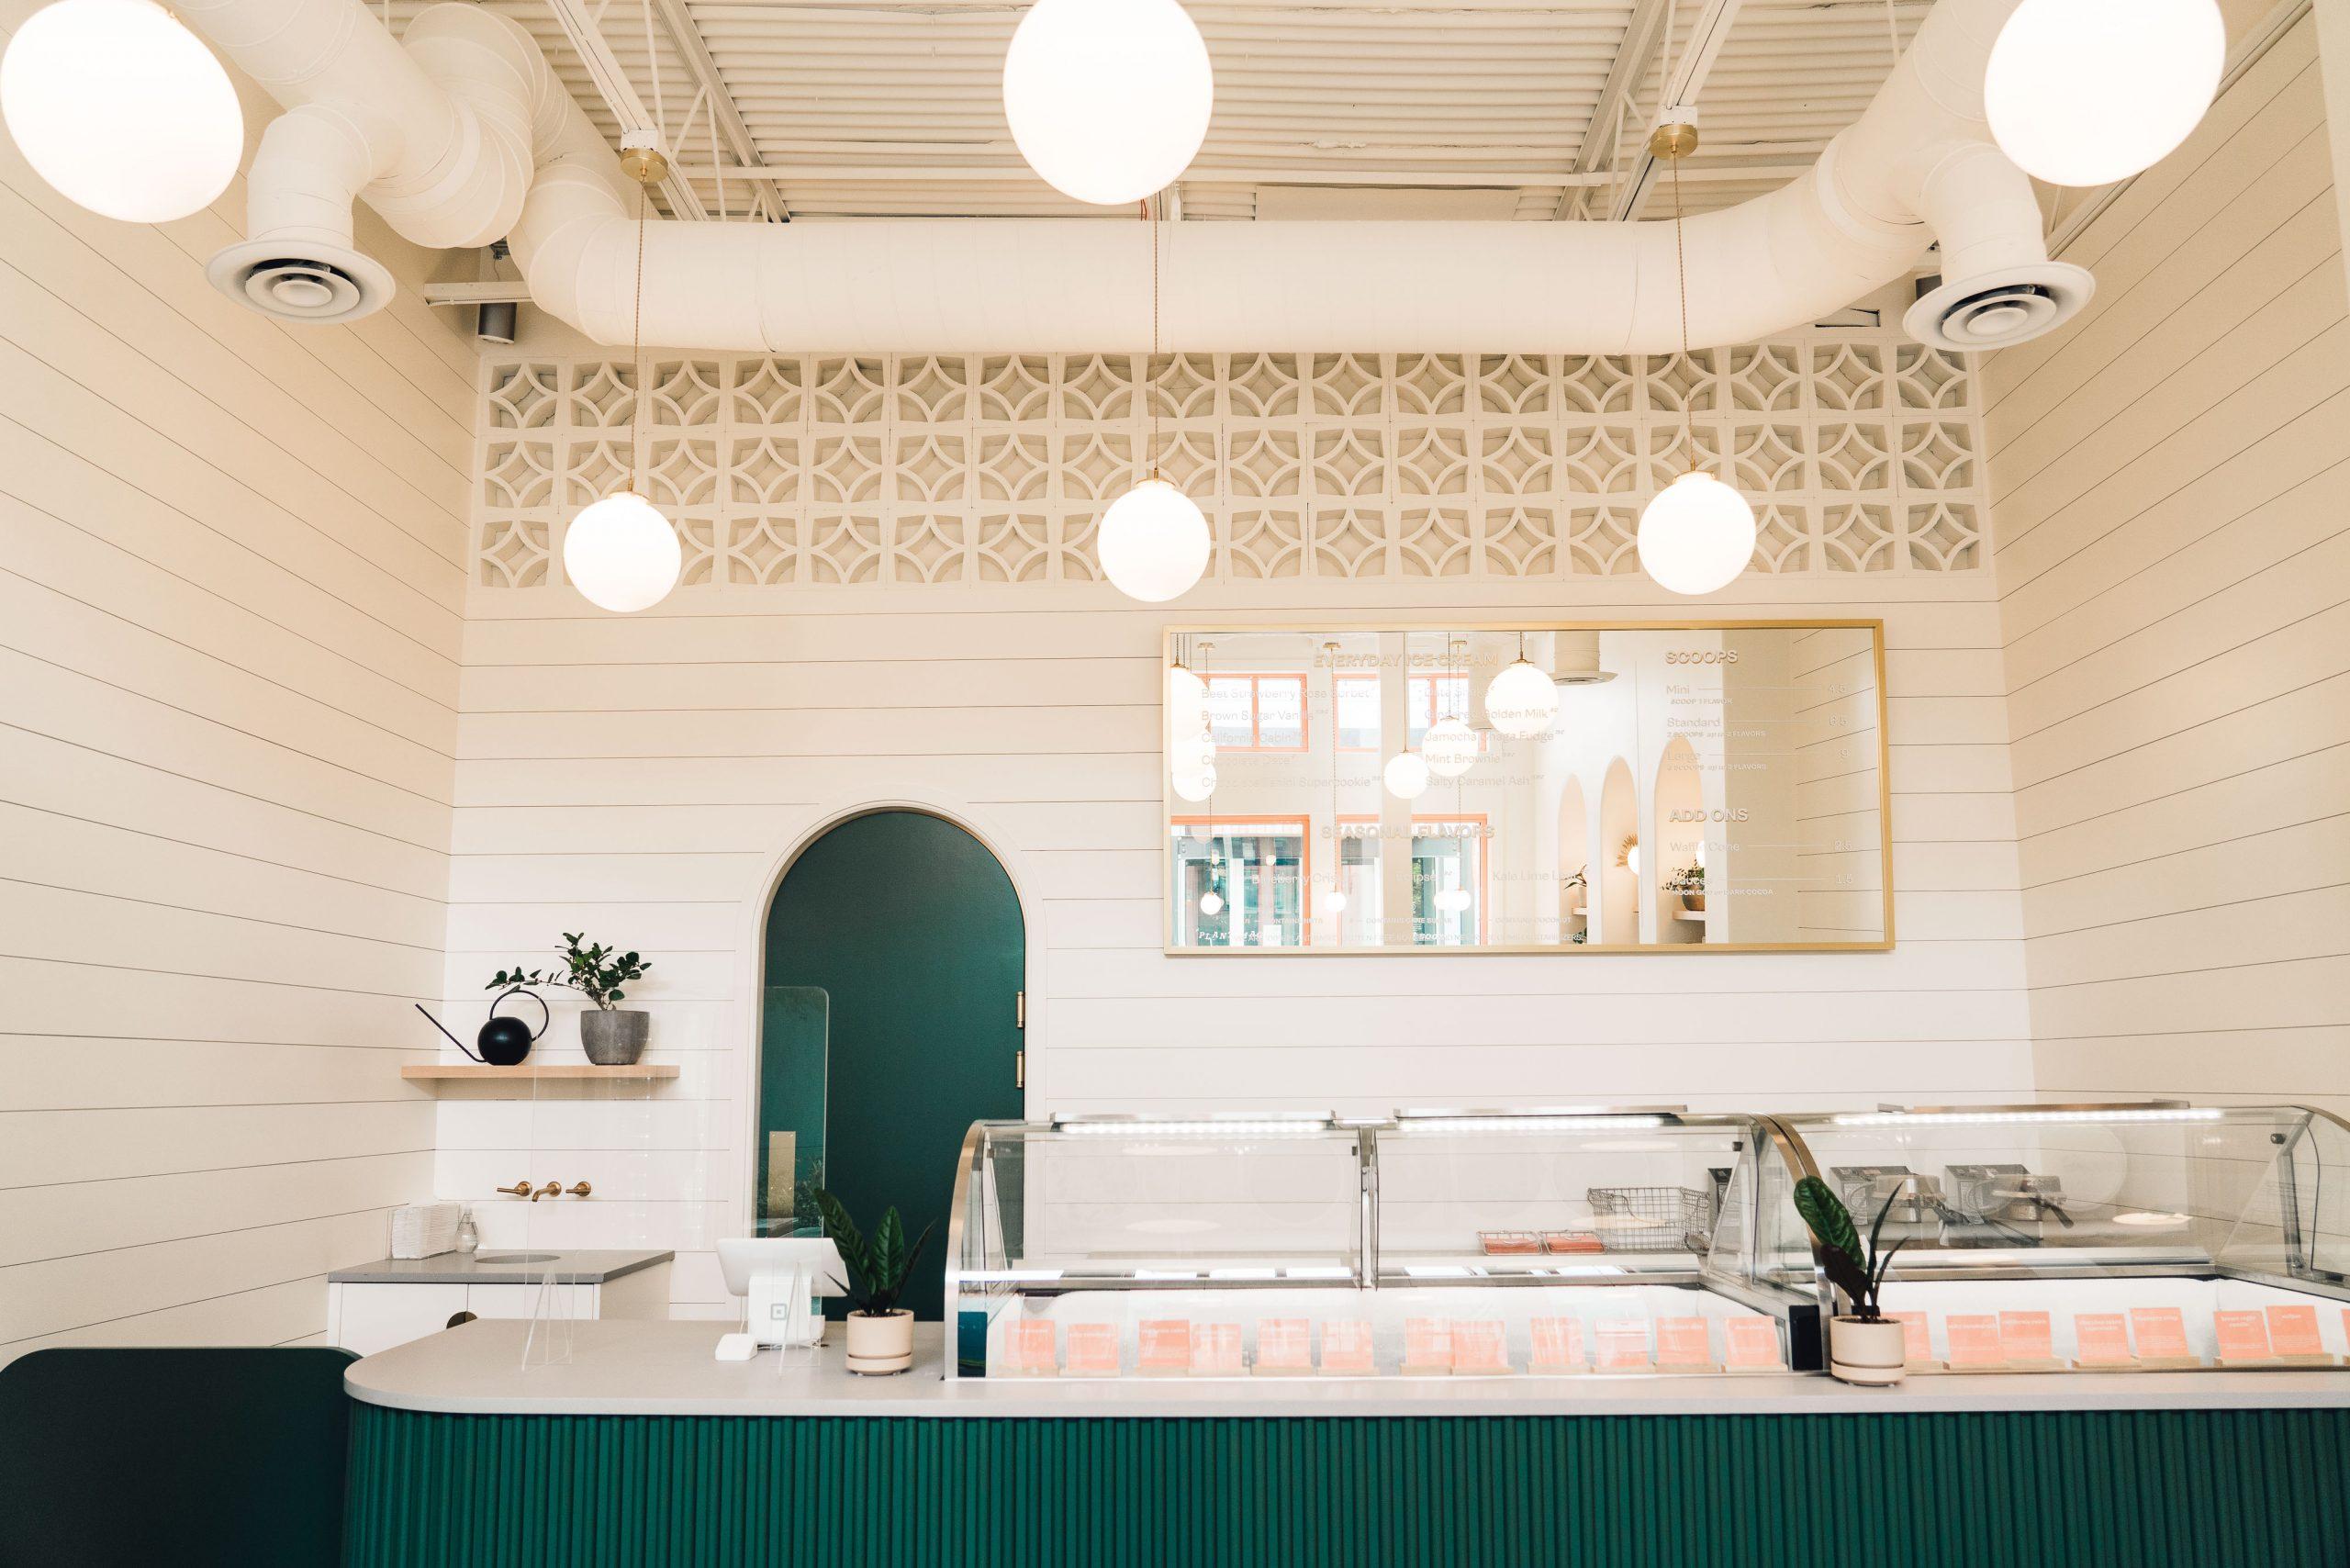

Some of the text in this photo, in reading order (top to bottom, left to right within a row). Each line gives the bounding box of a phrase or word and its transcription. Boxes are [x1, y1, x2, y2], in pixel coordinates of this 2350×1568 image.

[1313, 653, 1499, 668] EVERYDAY ICE CREAM
[1664, 650, 1739, 665] SCOOPS
[1202, 688, 1228, 699] Beet
[1231, 688, 1296, 701] Strawberry
[1665, 684, 1691, 696] Mini
[1202, 710, 1238, 721] Brown
[1241, 709, 1274, 723] Sugar
[1483, 707, 1521, 720] Golden
[1525, 707, 1550, 720] Milk
[1666, 716, 1721, 728] Standard
[1202, 732, 1255, 743] California
[1425, 731, 1477, 743] Jamocha
[1518, 731, 1555, 745] Fudge
[1426, 753, 1500, 765] Mint Brownie
[1667, 750, 1702, 763] Large
[1298, 776, 1371, 790] Supercookie
[1425, 775, 1530, 790] Salty Caramel Ash
[1668, 808, 1750, 823] ADD ONS
[1321, 824, 1496, 840] SEASONAL FLAVORS
[1708, 842, 1740, 852] Cone
[1521, 870, 1550, 881] Lime
